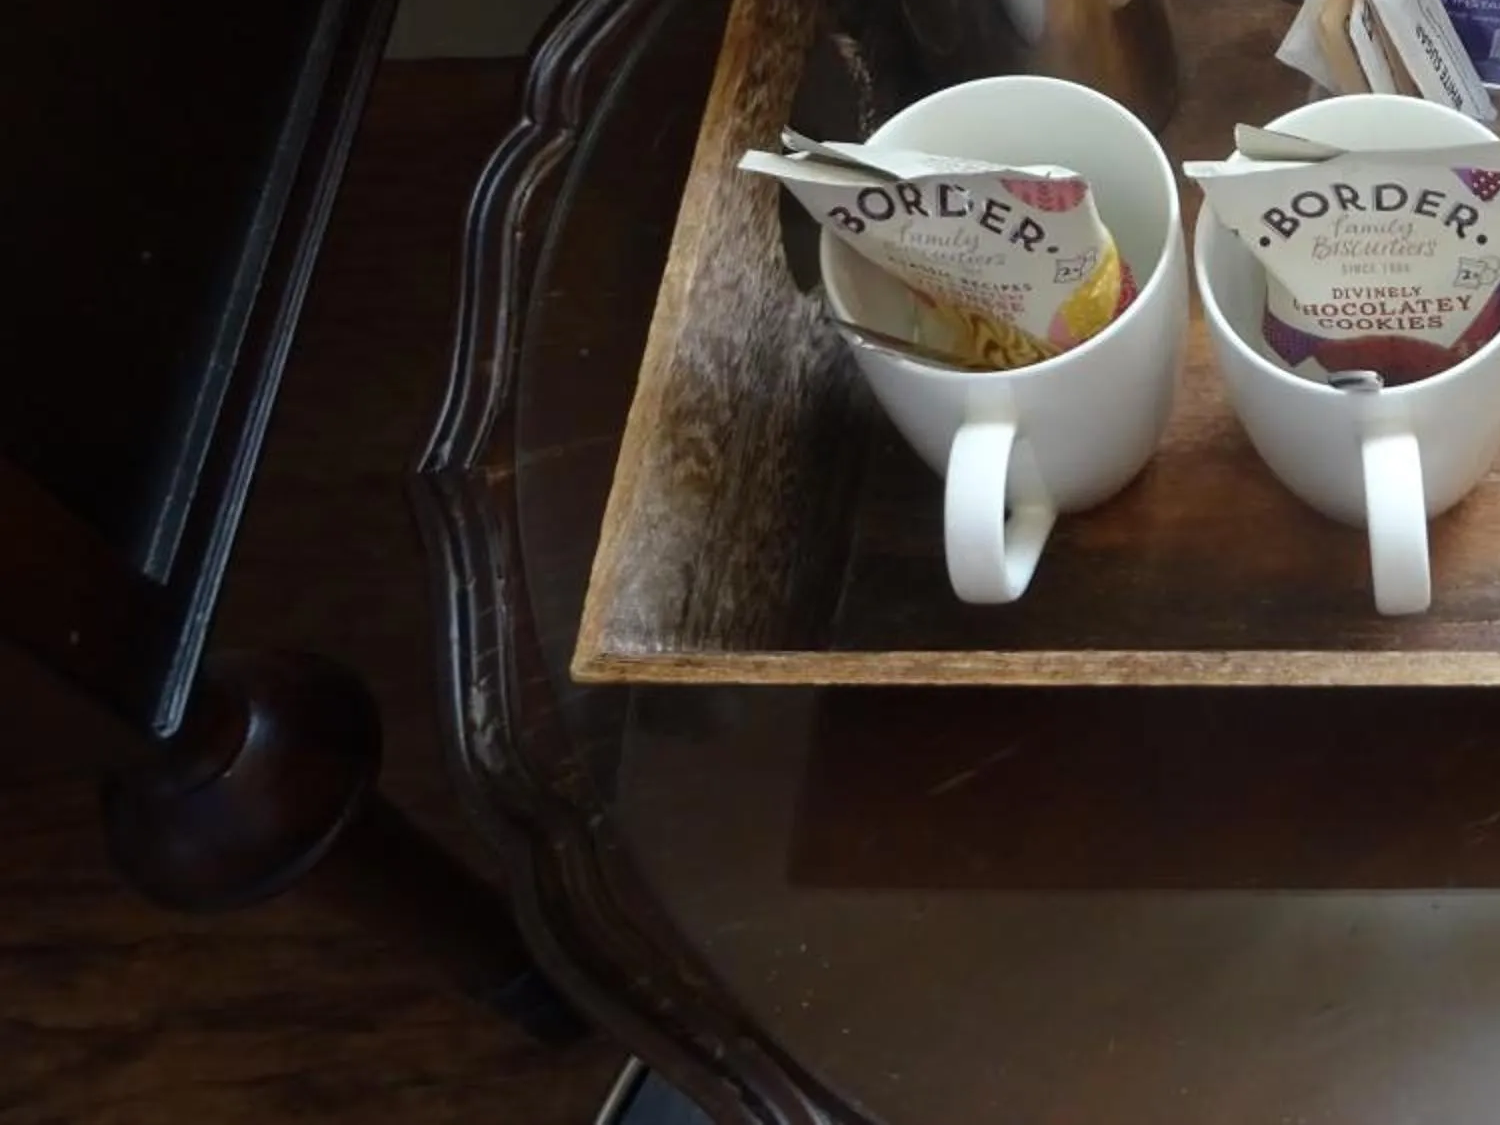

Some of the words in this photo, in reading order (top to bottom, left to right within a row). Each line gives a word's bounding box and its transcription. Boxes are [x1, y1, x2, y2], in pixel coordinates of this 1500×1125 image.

[828, 182, 1046, 252] BORDER
[1263, 183, 1479, 240] BORDER
[1332, 286, 1422, 300] DIVINELY
[1294, 294, 1472, 316] HOCOLATEY
[1317, 316, 1444, 330] COOKIES
